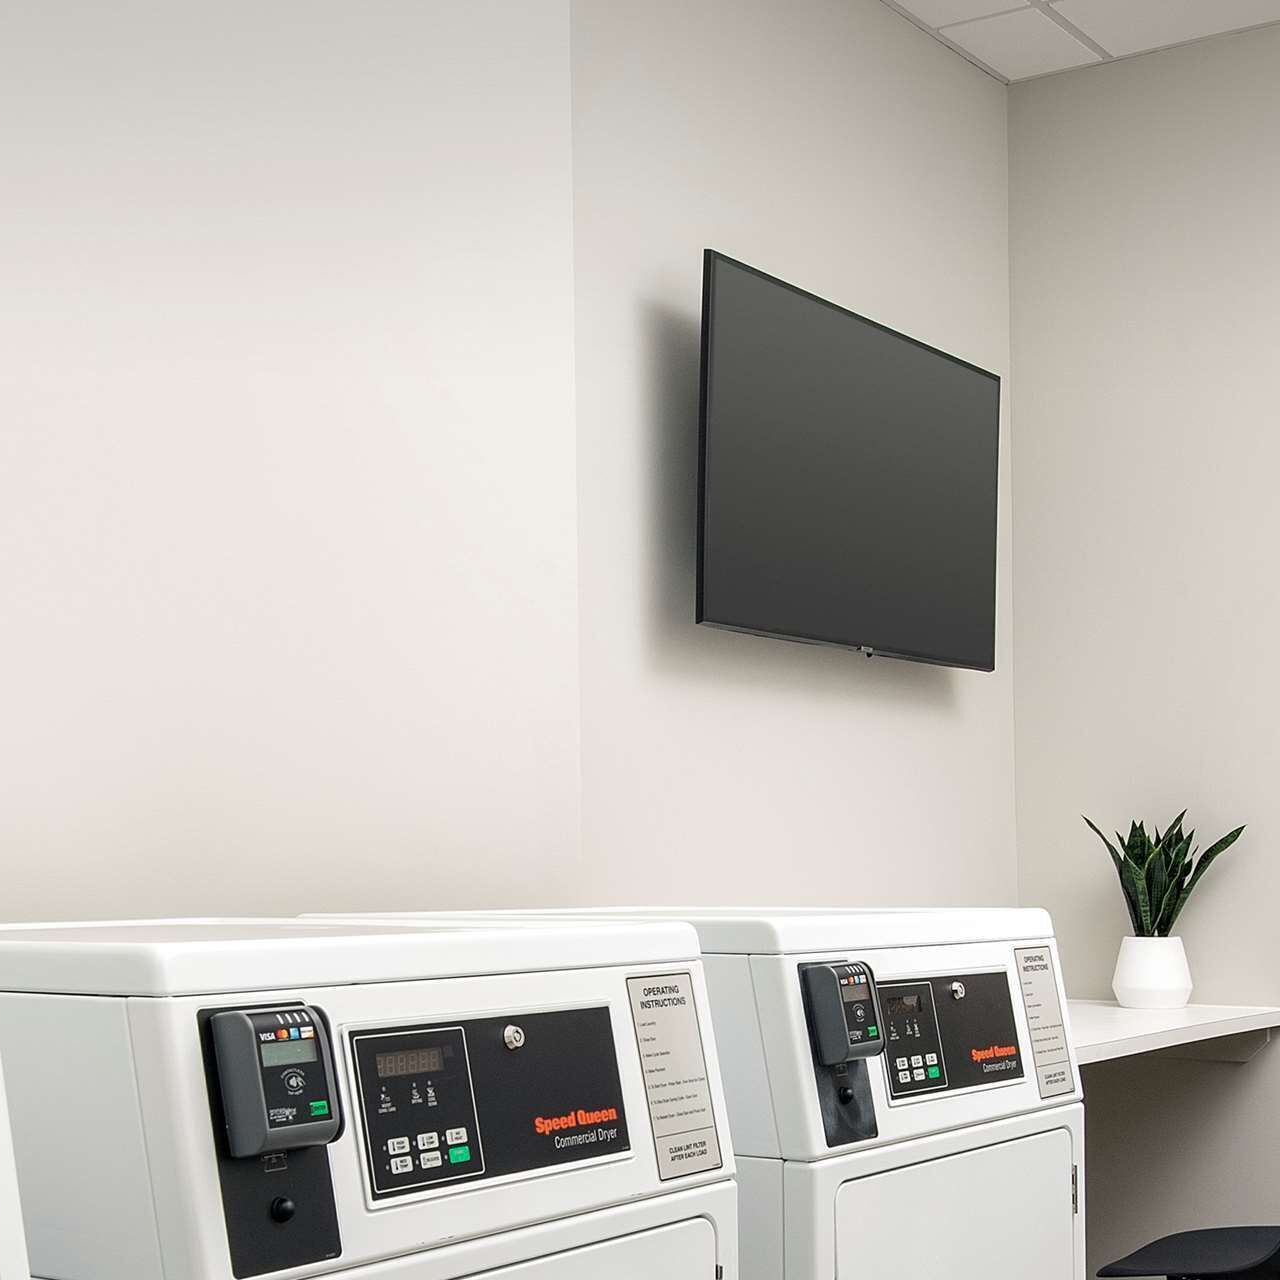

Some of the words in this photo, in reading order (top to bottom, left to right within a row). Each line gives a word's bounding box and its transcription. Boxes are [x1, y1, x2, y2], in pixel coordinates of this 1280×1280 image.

[643, 985, 679, 996] OPERATING
[640, 997, 686, 1009] INSTRUCTIONS
[259, 1033, 276, 1041] VISA
[535, 1112, 576, 1135] Speed
[577, 1108, 617, 1125] Queen
[555, 1130, 597, 1148] Commercial
[598, 1128, 617, 1142] Dryer
